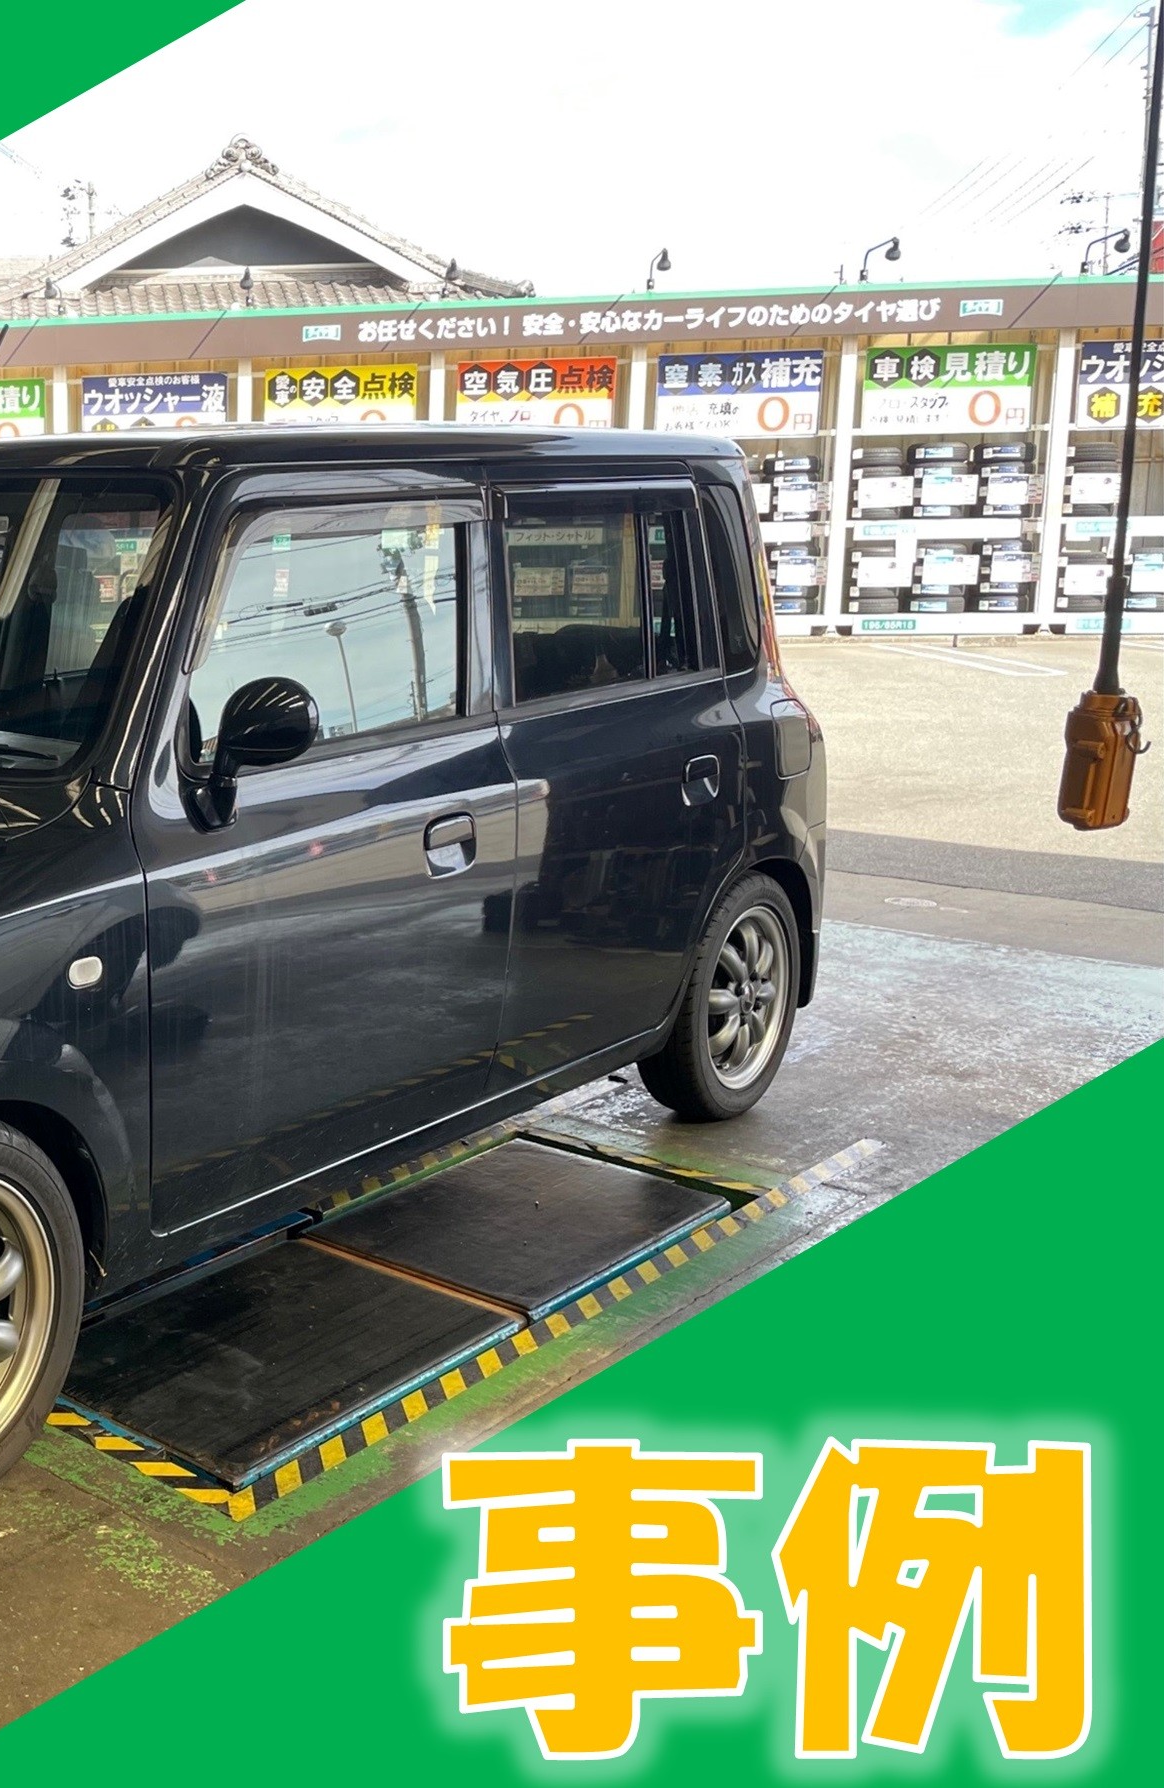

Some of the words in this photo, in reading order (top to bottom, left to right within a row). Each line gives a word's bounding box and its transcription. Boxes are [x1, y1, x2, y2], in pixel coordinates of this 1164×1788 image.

[357, 316, 511, 342] お任せください！
[522, 297, 942, 336] 安全・安心なカーライフのためのタイヤ選び
[108, 374, 200, 387] 愛車安全点検のお客様
[463, 364, 614, 394] 空気圧点検
[663, 356, 823, 389] 窒素ガス補充
[873, 350, 1031, 382] 車検見積り
